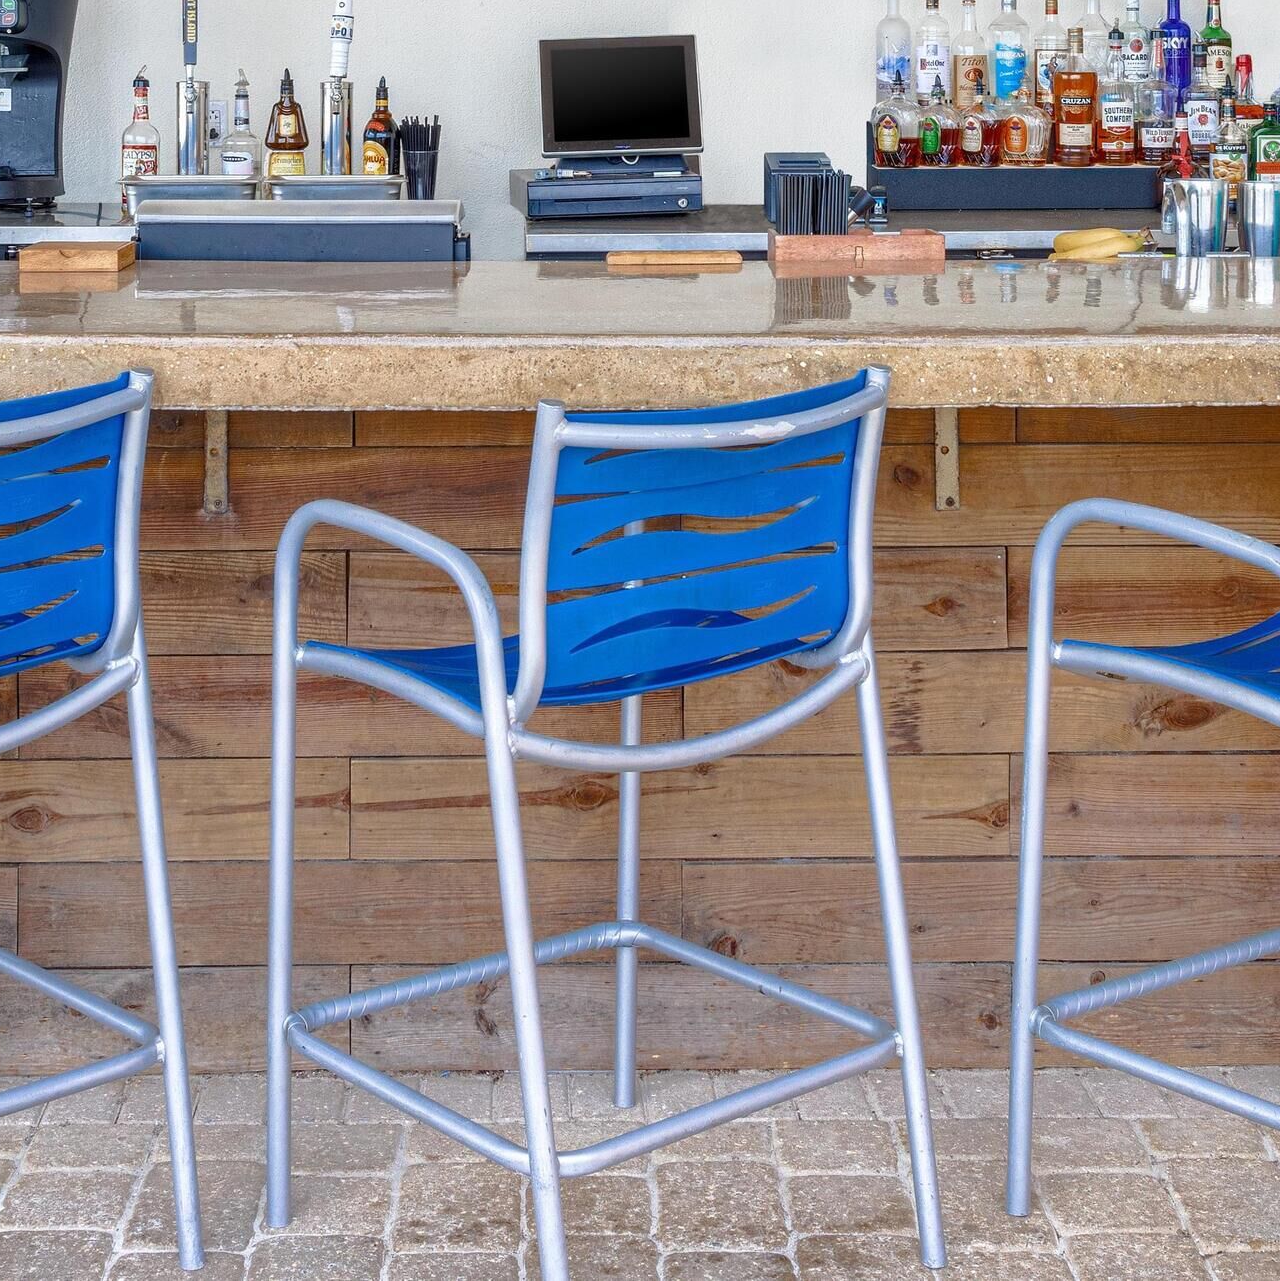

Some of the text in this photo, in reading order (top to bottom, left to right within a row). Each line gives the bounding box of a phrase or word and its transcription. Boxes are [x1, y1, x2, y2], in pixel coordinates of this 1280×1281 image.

[187, 10, 197, 43] ISLAND
[1162, 37, 1188, 49] SKYY
[961, 57, 985, 67] Tito's
[1061, 97, 1092, 105] CRUZAN
[1104, 106, 1133, 115] SOUTHERN
[1189, 104, 1217, 117] JIM BEAM
[1105, 114, 1132, 123] COMFORT
[1145, 128, 1158, 136] WILD
